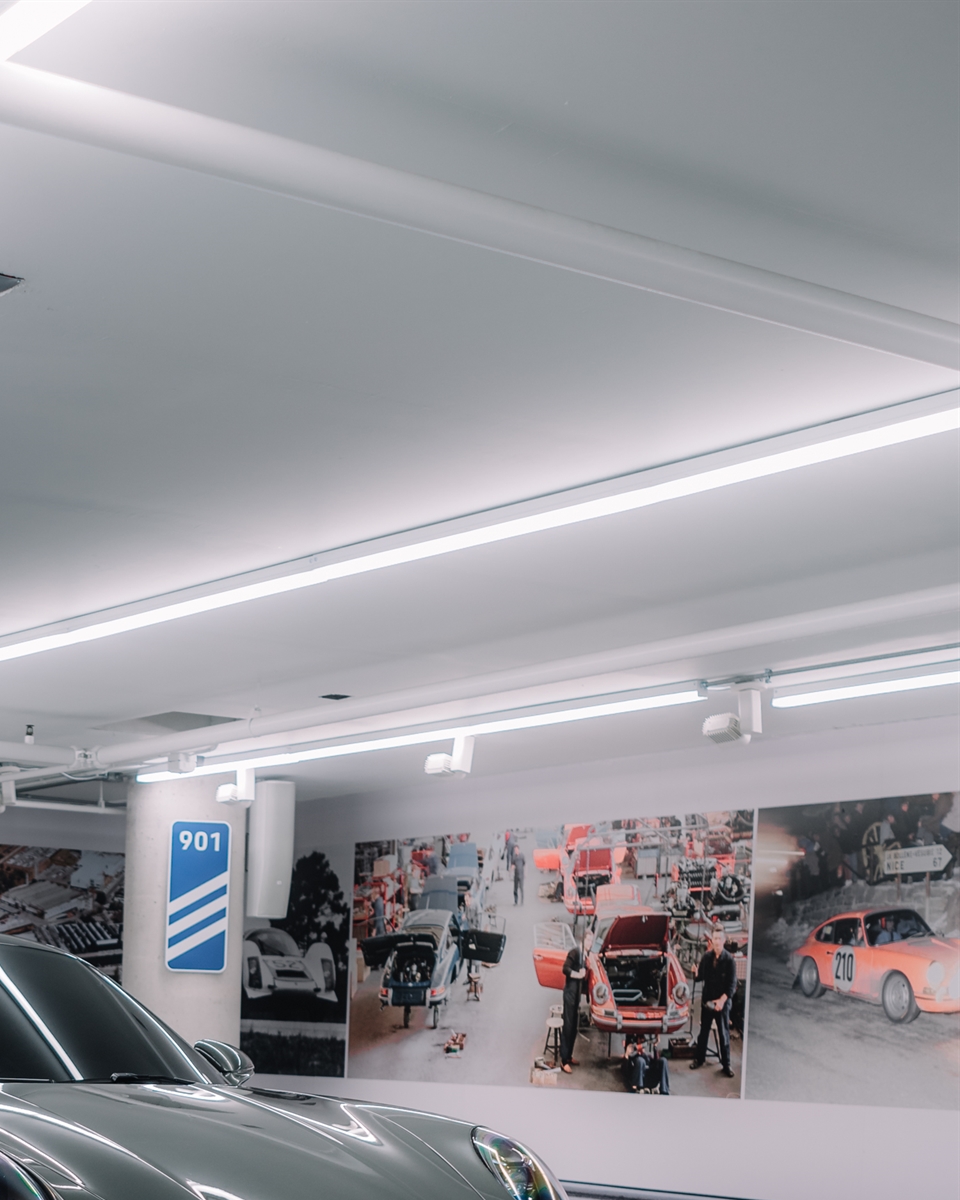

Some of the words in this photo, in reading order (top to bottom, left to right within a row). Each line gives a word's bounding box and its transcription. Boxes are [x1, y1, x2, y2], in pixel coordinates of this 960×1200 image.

[179, 830, 220, 851] 901
[886, 860, 905, 871] NICE
[933, 857, 942, 868] 67
[835, 952, 854, 982] 210
